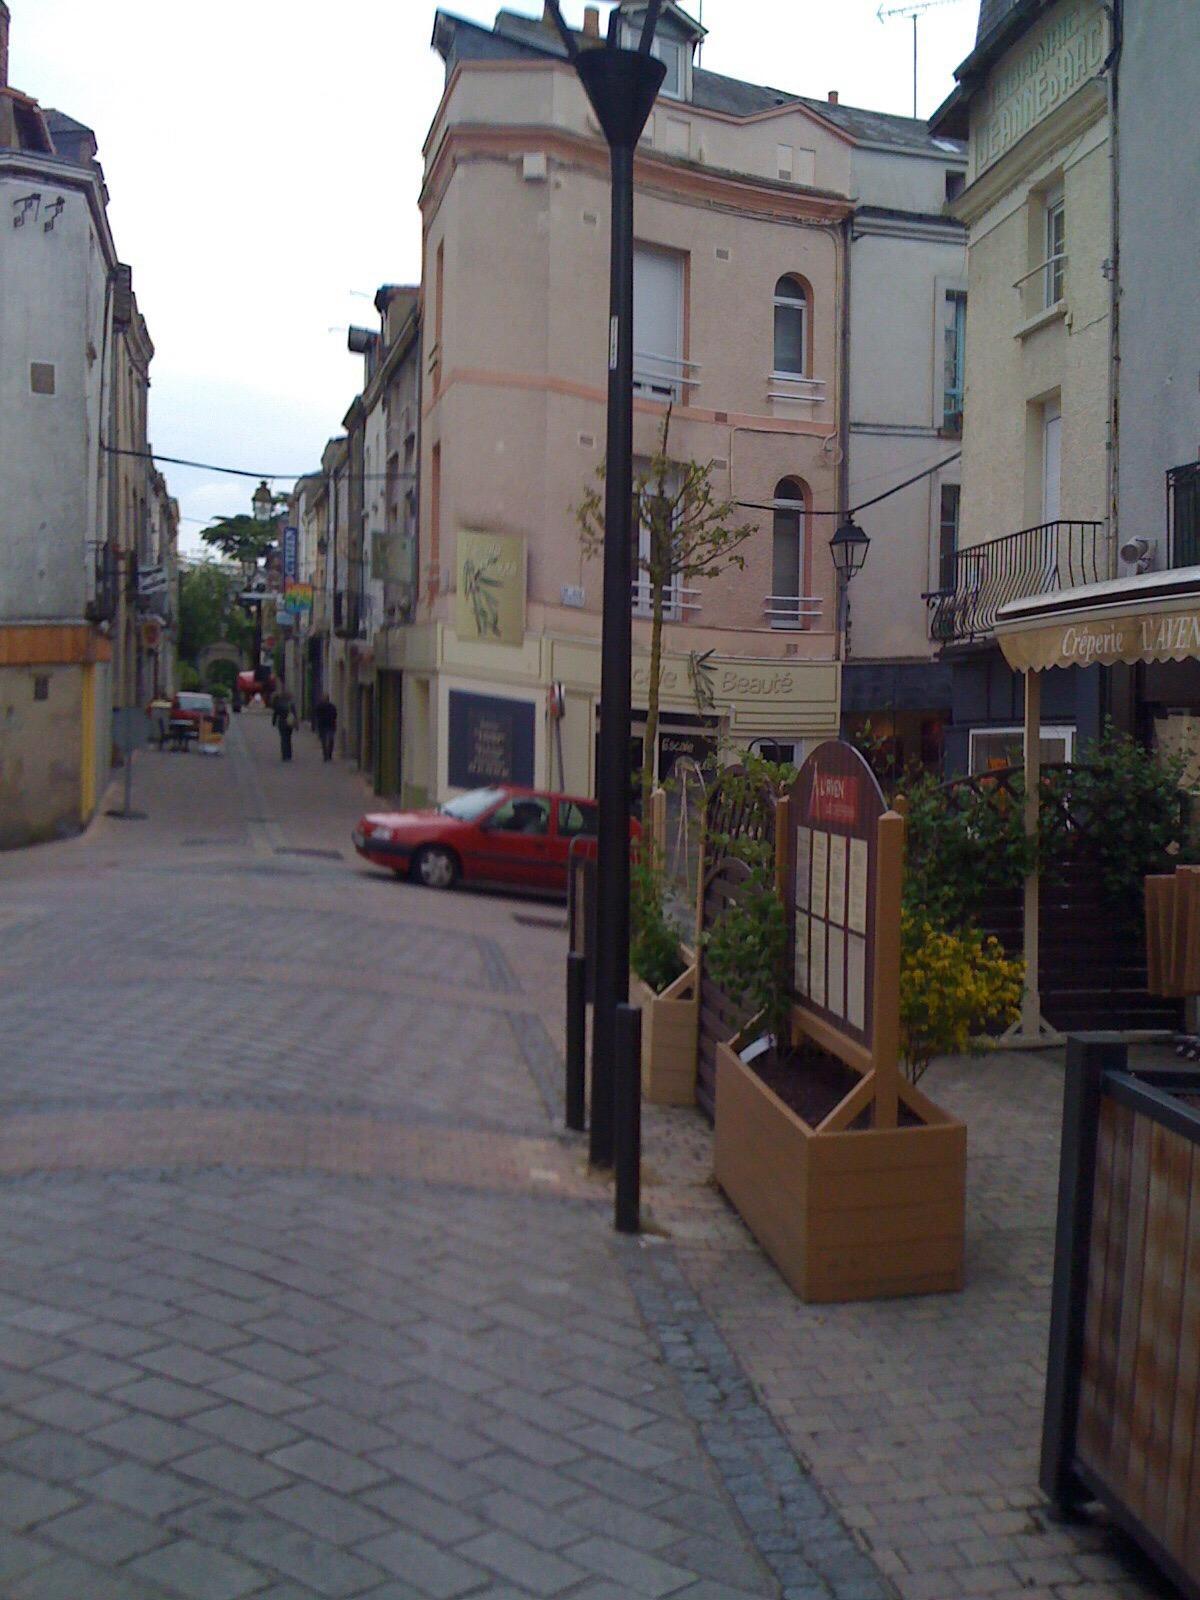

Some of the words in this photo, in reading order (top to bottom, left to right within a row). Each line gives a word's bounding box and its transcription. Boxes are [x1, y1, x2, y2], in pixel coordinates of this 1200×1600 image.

[976, 72, 1049, 170] JEANNE
[1062, 624, 1124, 662] Crêperie
[721, 671, 794, 695] Beauté
